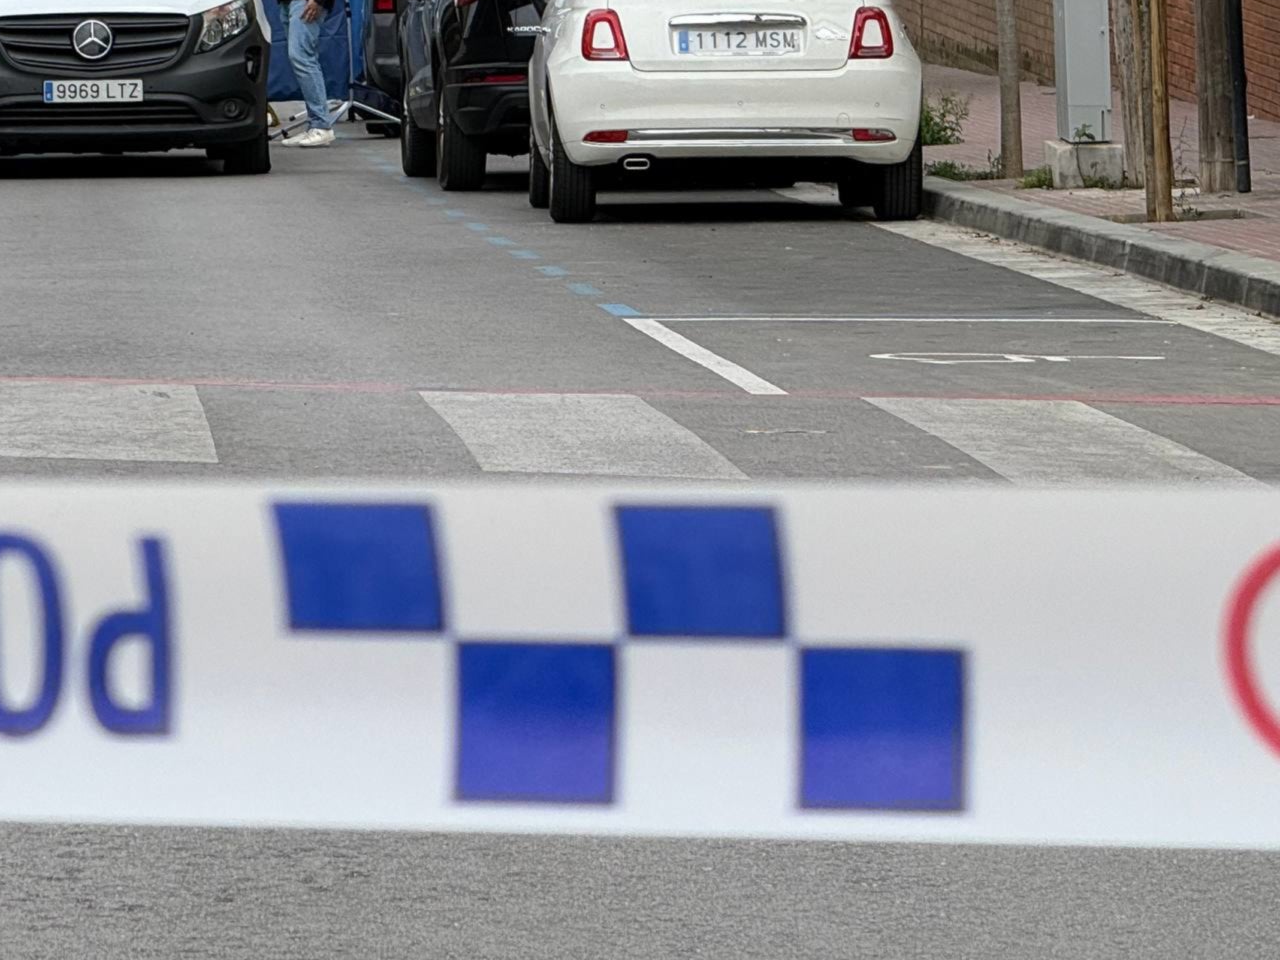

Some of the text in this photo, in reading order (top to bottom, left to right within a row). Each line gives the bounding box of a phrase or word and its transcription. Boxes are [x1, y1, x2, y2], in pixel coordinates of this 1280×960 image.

[696, 31, 795, 49] 1112 MSM
[56, 82, 139, 99] 9969 LTZ
